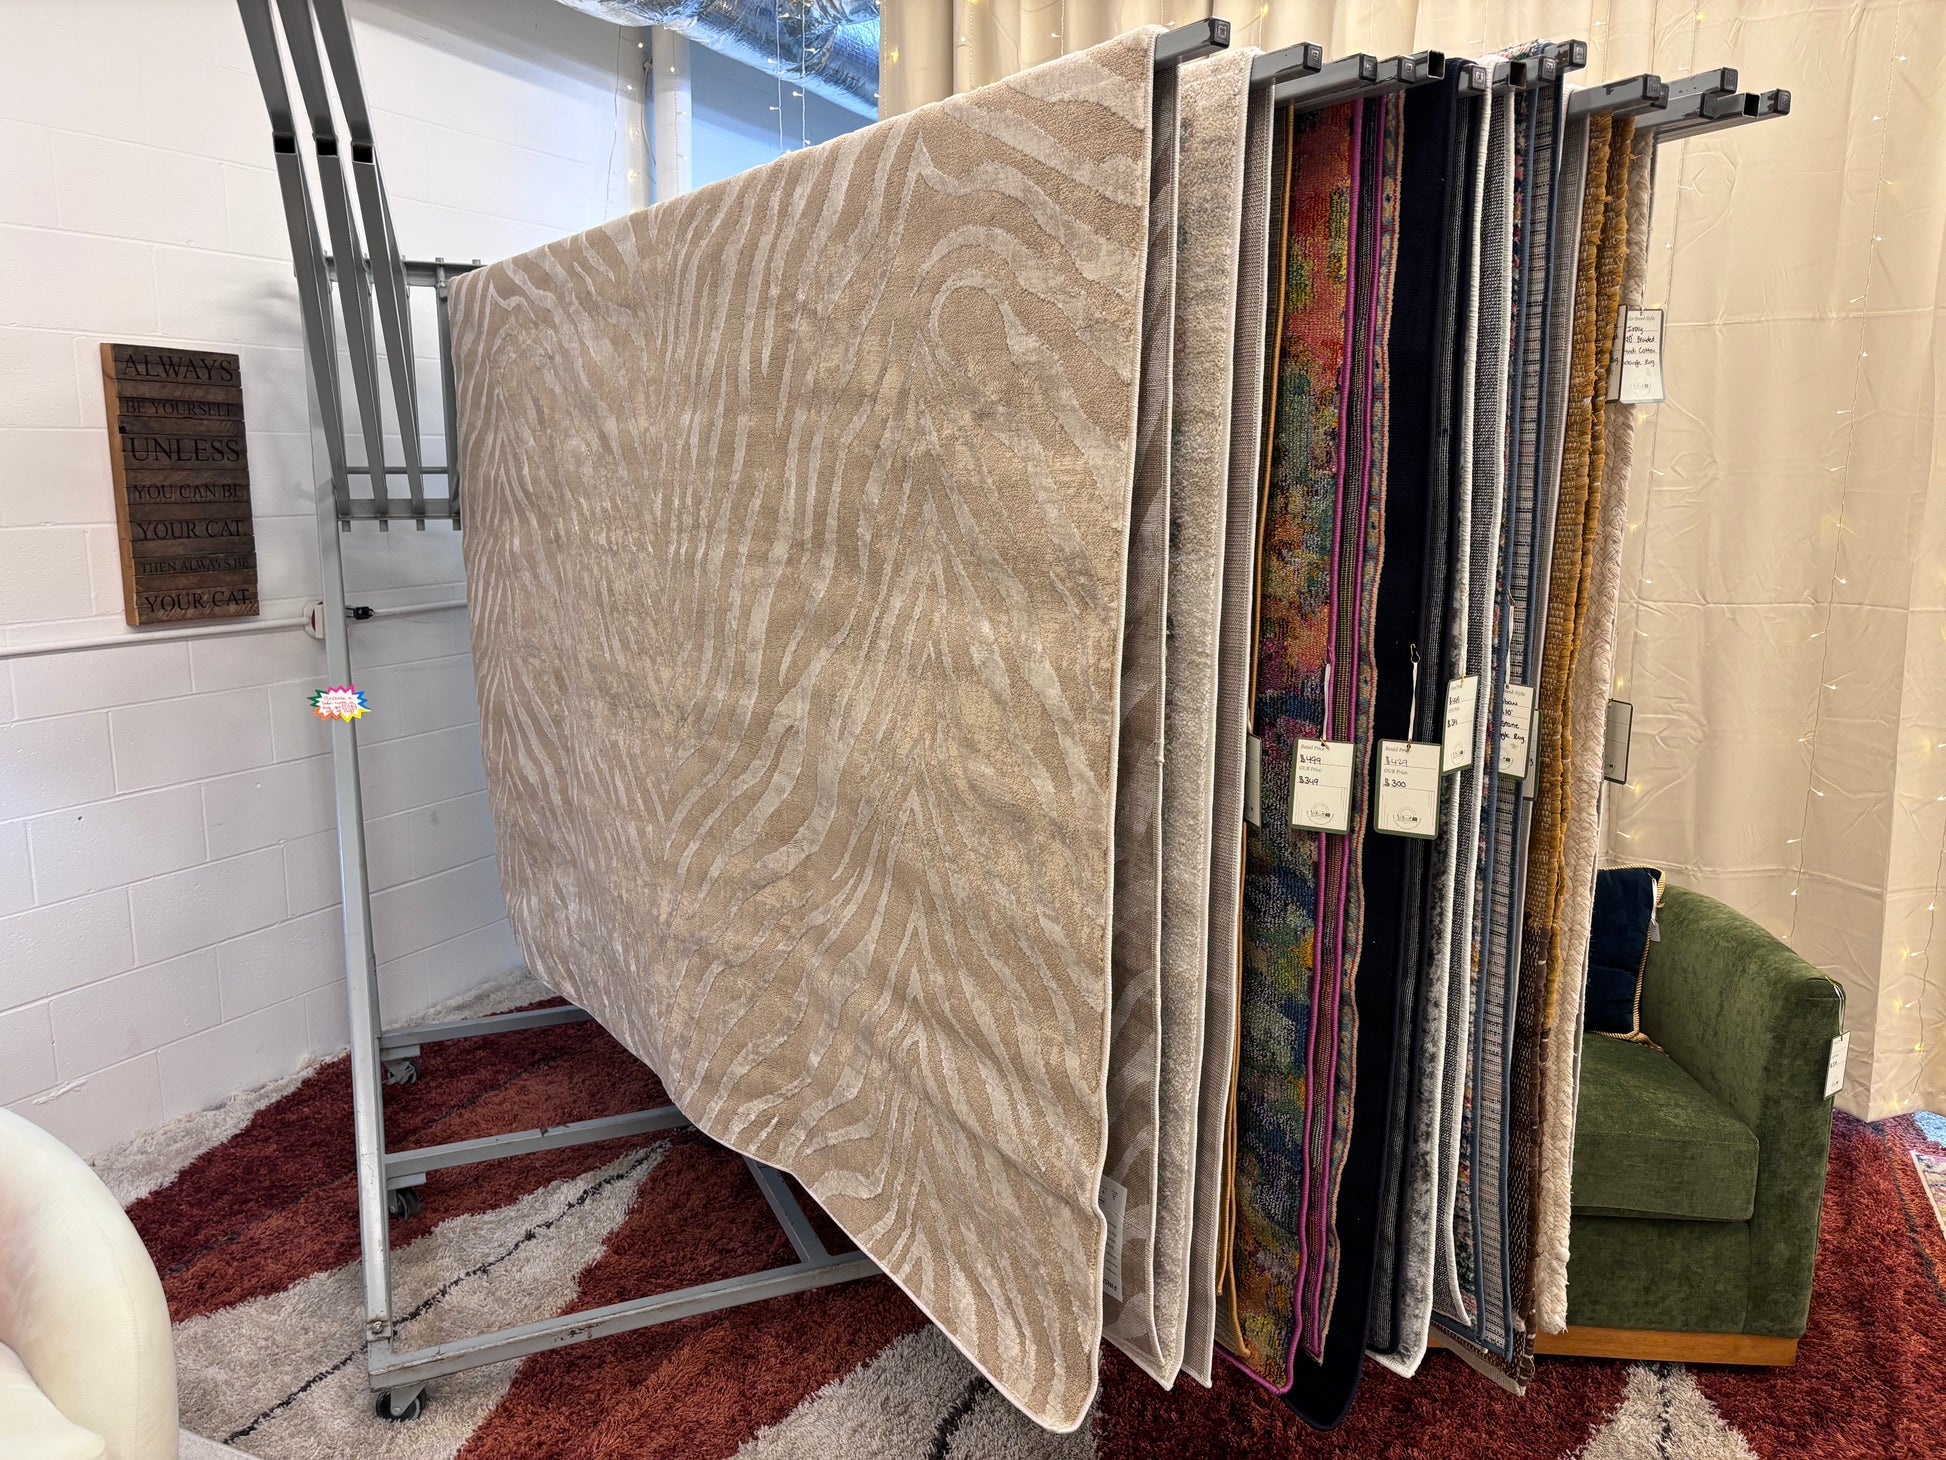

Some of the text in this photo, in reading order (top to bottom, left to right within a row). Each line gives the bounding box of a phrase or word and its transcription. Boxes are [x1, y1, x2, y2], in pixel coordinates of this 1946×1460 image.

[122, 354, 233, 382] ALWAYS
[126, 400, 147, 413] BE
[128, 437, 240, 462] UNLESS
[133, 483, 244, 499] YOU CAN BE
[136, 520, 247, 539] YOUR CAT.
[142, 558, 249, 574] THEN ALWAYS BE
[144, 588, 253, 613] YOUR CAT.
[1513, 733, 1525, 744] Rug
